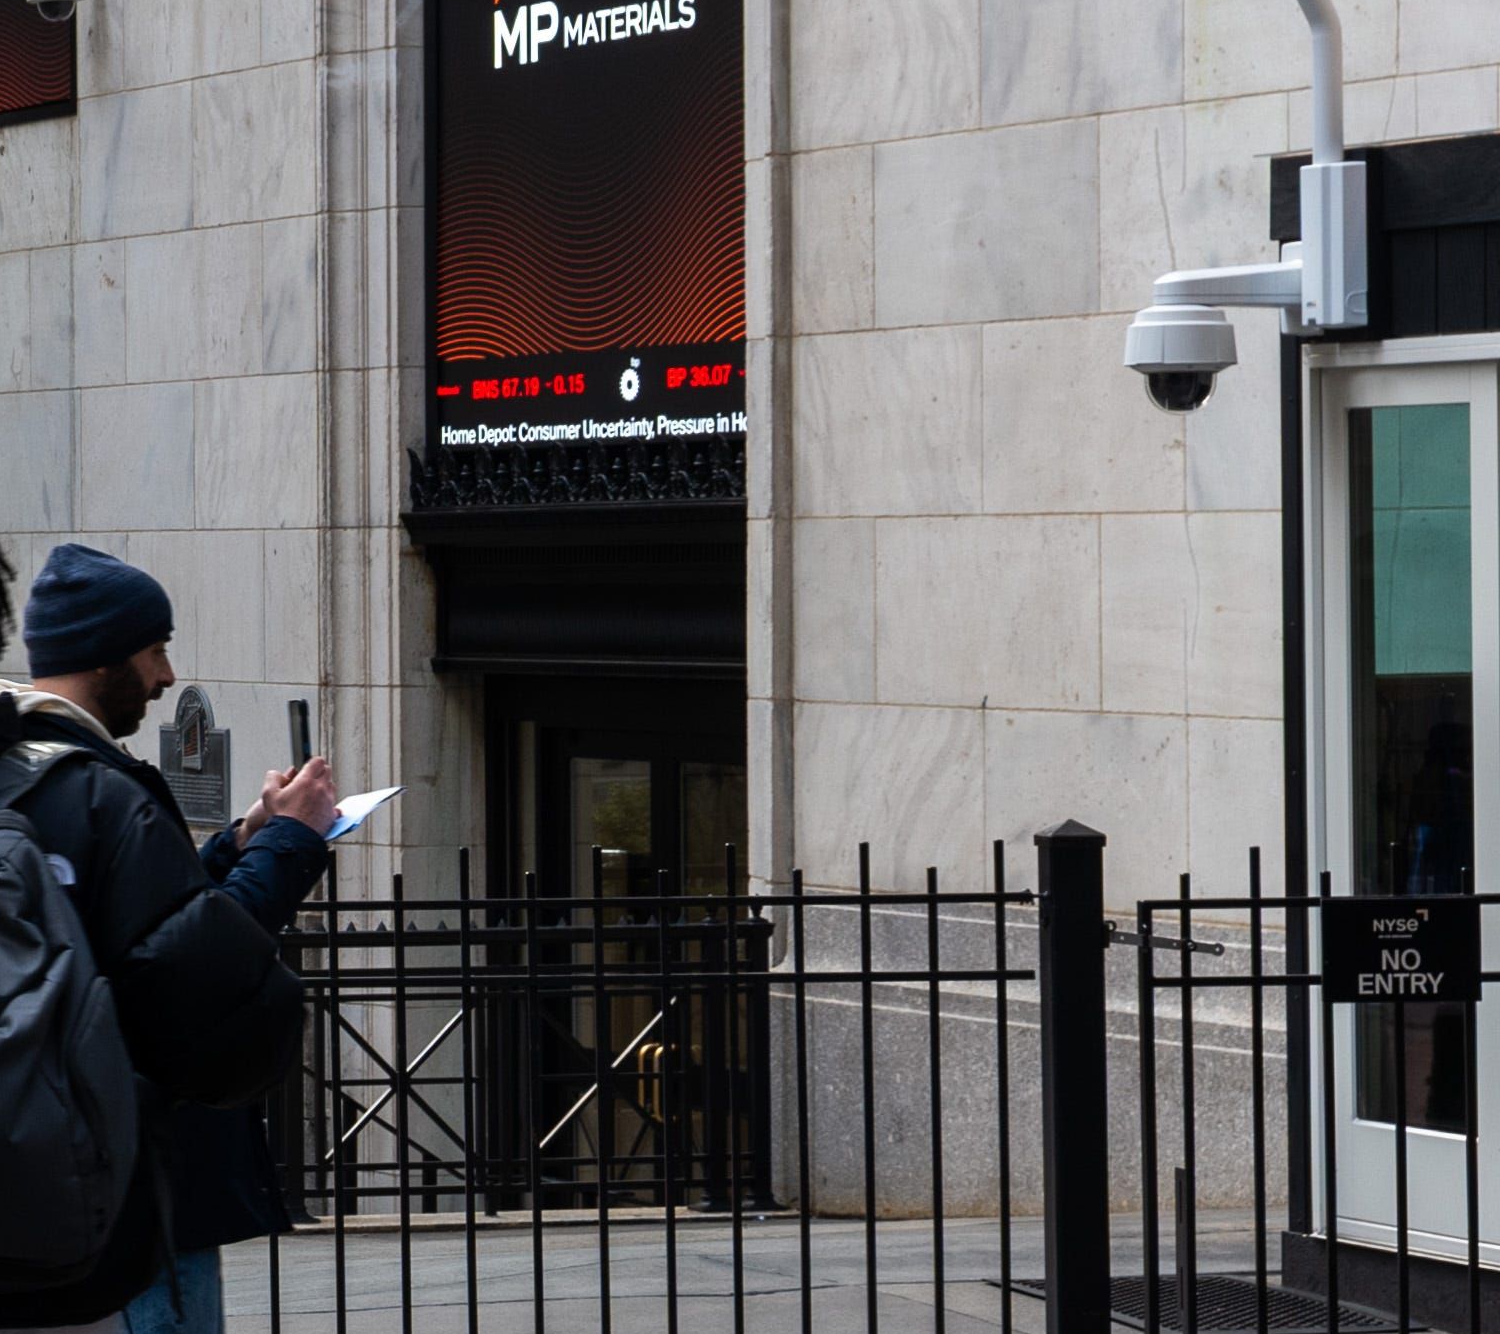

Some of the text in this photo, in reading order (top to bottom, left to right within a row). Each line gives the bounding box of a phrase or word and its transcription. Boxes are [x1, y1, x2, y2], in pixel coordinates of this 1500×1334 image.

[493, 0, 560, 70] MP
[472, 378, 499, 400] BNS
[501, 376, 540, 398] 67.19
[666, 366, 687, 389] BP
[689, 363, 732, 387] 36.07
[441, 424, 476, 445] Home
[477, 422, 516, 447] Depot:
[517, 419, 581, 443] Consumer
[582, 415, 656, 440] Uncertainty,
[656, 414, 715, 436] Pressure
[716, 412, 729, 433] in
[1381, 948, 1422, 971] NO
[1358, 972, 1444, 995] ENTRY
